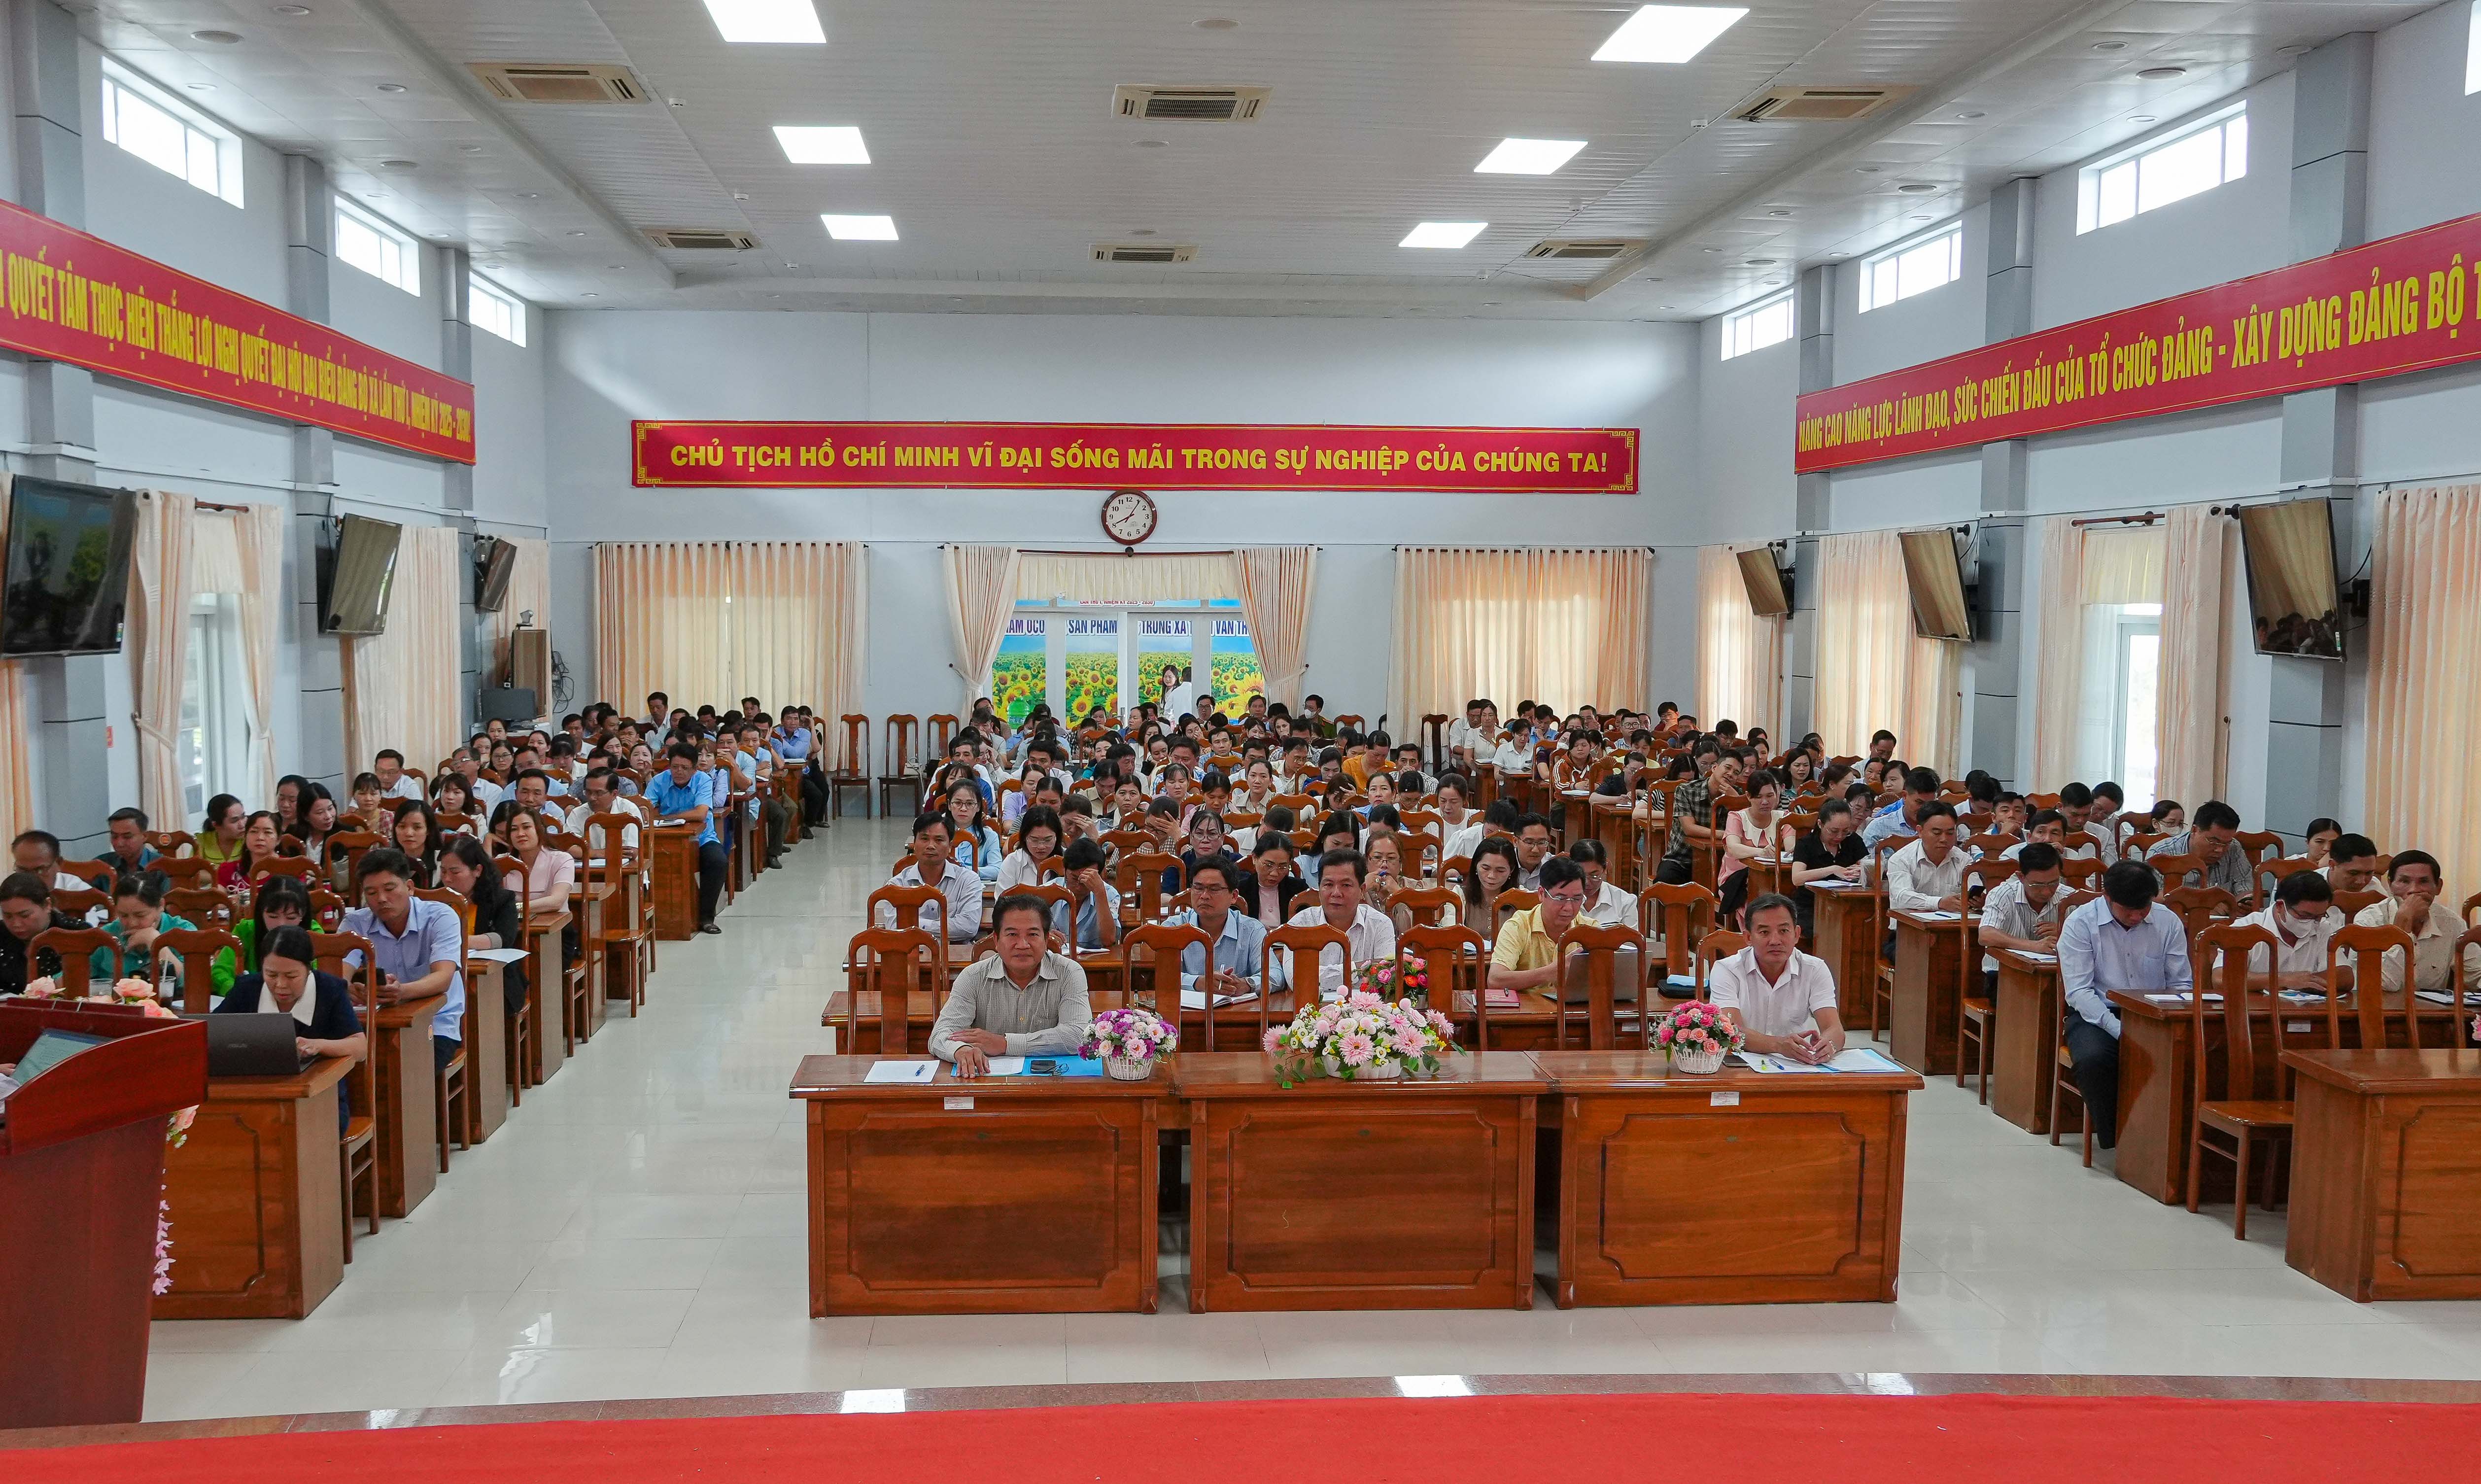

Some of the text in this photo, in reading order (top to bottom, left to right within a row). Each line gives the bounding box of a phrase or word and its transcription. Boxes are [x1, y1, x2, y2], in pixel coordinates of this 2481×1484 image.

[8, 245, 54, 322] QUYẾT
[58, 260, 88, 332] TÂM
[90, 280, 124, 351] THỰC
[126, 285, 155, 360] HIỆN
[157, 289, 194, 363] THẮNG
[196, 315, 213, 378] LỢI
[215, 323, 240, 386] NGHỊ
[241, 324, 269, 383] QUYẾT
[1799, 413, 1823, 452] NÂNG
[1825, 415, 1842, 447] CAO
[1845, 404, 1871, 444] NĂNG
[1874, 399, 1892, 446] LỰC
[1895, 391, 1922, 436] LÃNH
[1924, 389, 1950, 437] ĐẠO,
[1954, 375, 1977, 424] SỨC
[1981, 360, 2019, 418] CHIẾN
[2023, 351, 2051, 410] ĐẤU
[2055, 344, 2084, 403] CỦA
[2089, 331, 2110, 396] TỔ
[2112, 331, 2157, 392] CHỨC
[2162, 315, 2212, 383] ĐẢNG
[2218, 345, 2226, 355] -
[2231, 304, 2274, 368] XÂY
[2278, 295, 2342, 368] DỰNG
[2348, 266, 2419, 345] ĐẢNG
[2427, 253, 2465, 339] BỘ
[671, 437, 1608, 476] CHỦ TỊCH HỒ CHÍ MINH VĨ ĐẠI SỐNG MÃI TRONG SỰ NGHIỆP CỦA CHÚNG TA!
